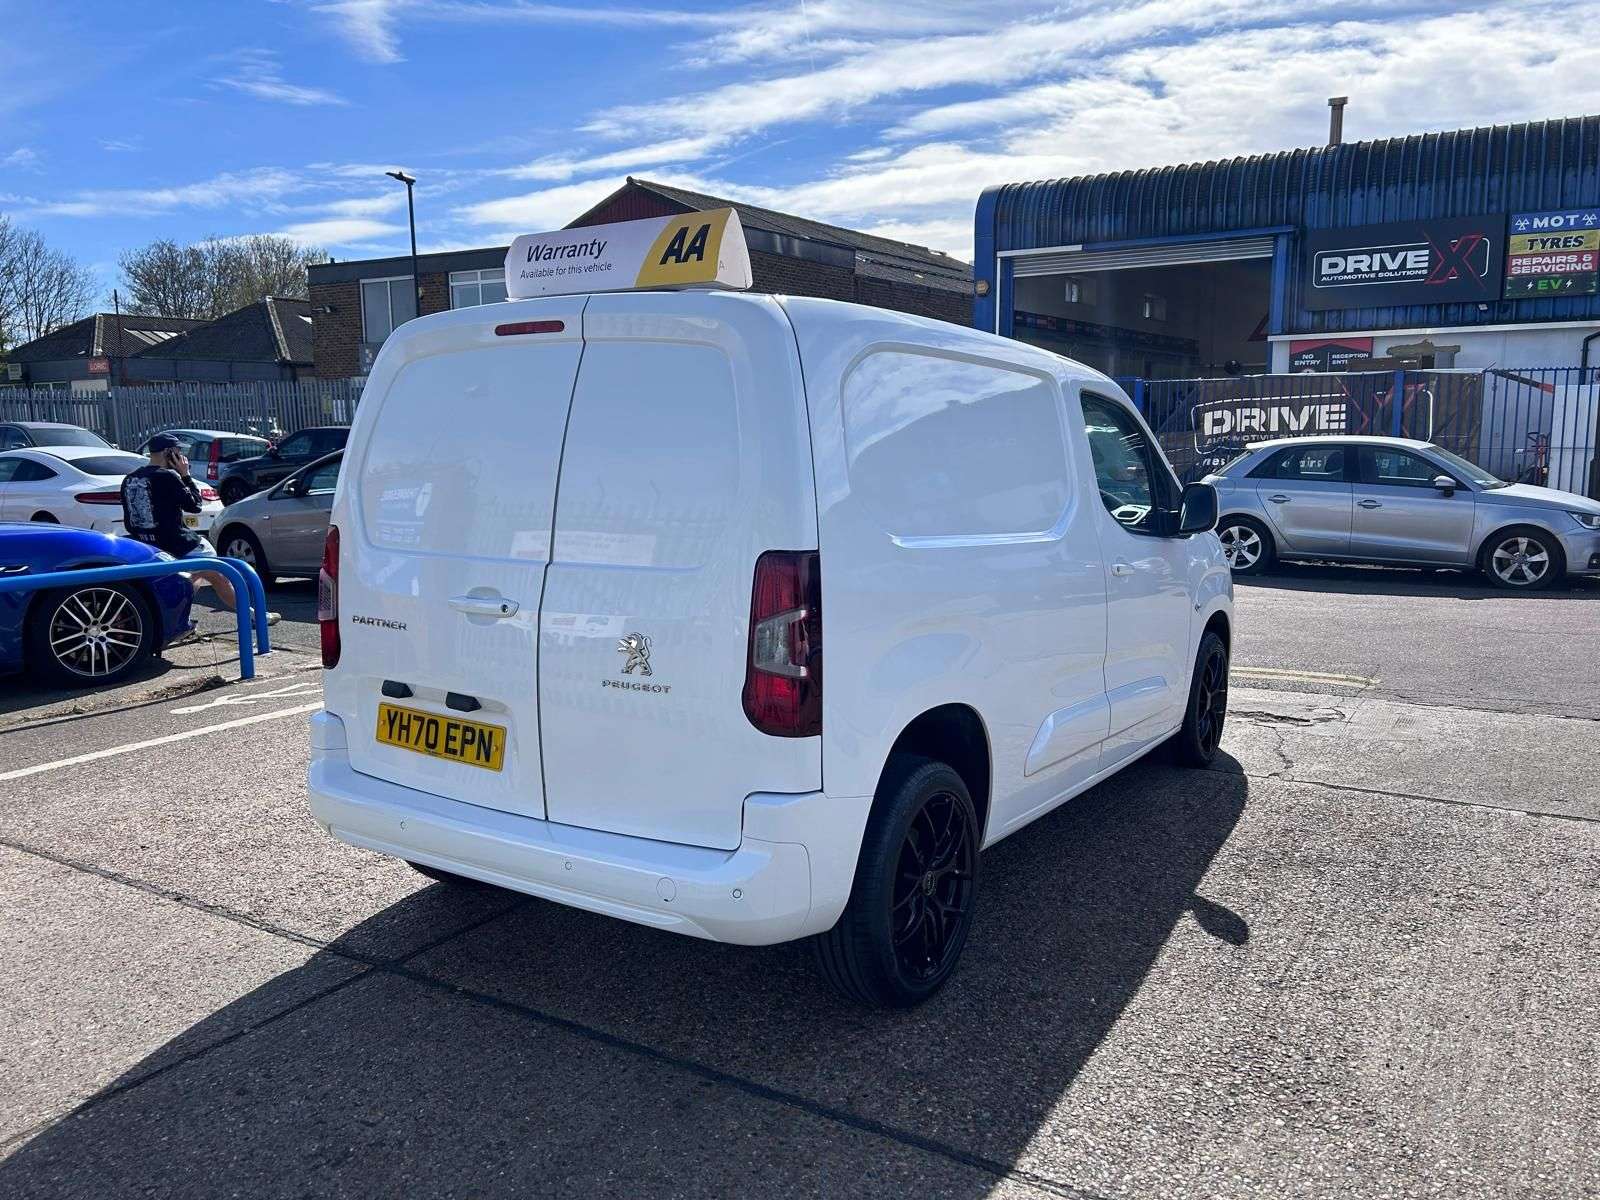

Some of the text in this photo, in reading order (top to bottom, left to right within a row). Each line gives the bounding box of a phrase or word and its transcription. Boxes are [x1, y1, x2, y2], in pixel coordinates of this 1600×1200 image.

[1533, 215, 1580, 229] MOT
[659, 224, 711, 265] AA
[1528, 235, 1584, 250] TYRES
[526, 238, 607, 263] Warranty
[1321, 250, 1429, 275] DRIVE
[1512, 254, 1592, 265] REPAIRS &
[520, 261, 612, 279] Available for this vehicle
[1321, 268, 1428, 282] AUTOMOTIVE SOLUTIONS
[1512, 263, 1592, 274] SERVICING
[1537, 279, 1562, 290] EV
[1204, 404, 1346, 436] DRIVE
[352, 615, 408, 631] PARTNER
[602, 679, 671, 694] PEUGEOT
[386, 708, 493, 763] YH70 EPN
